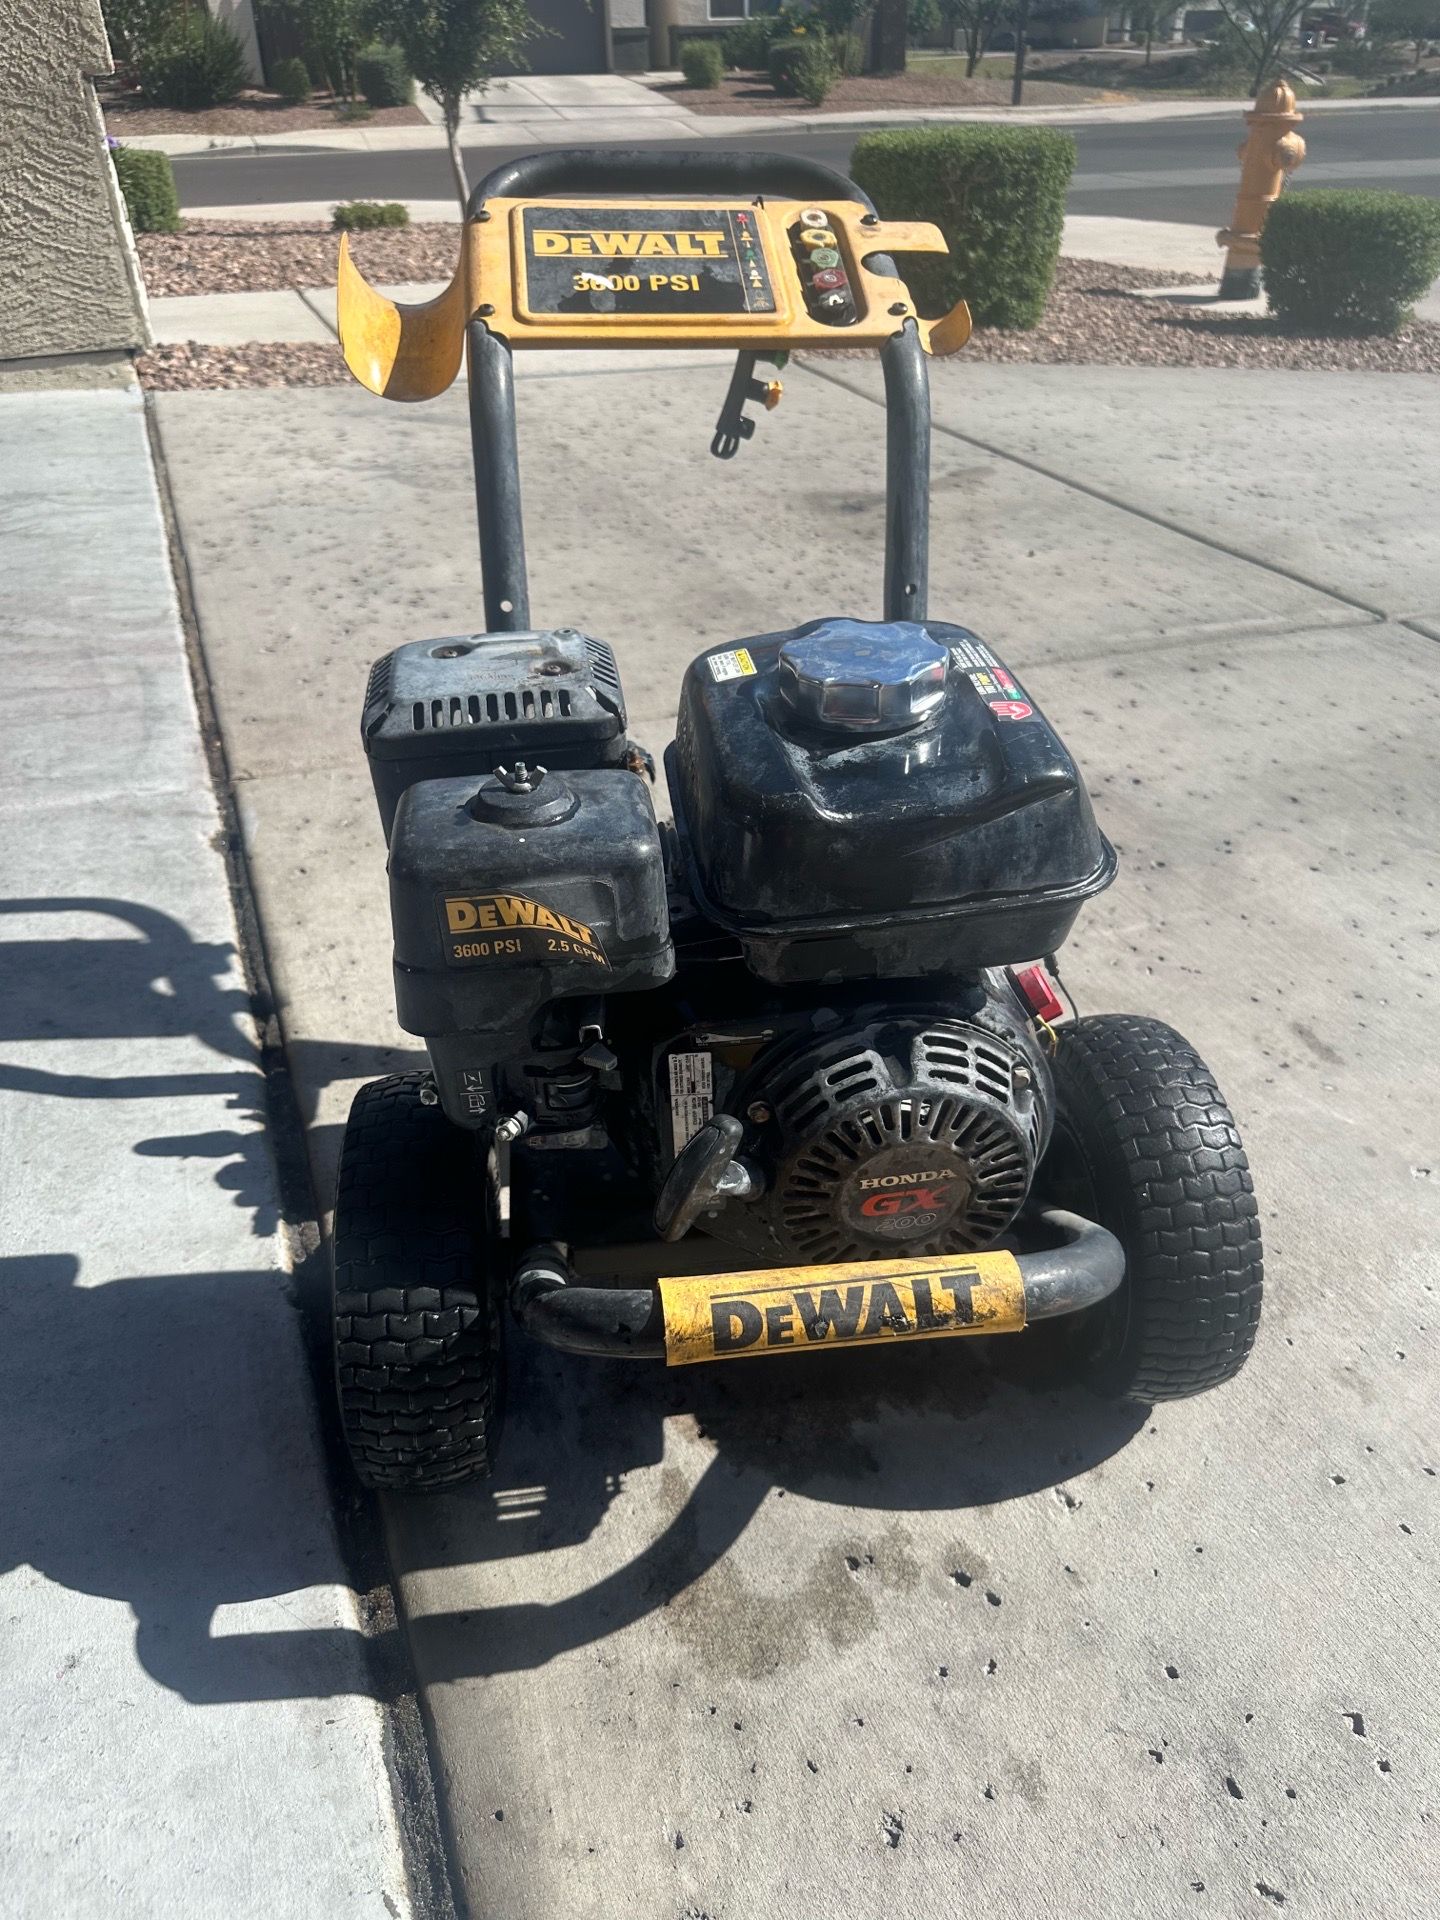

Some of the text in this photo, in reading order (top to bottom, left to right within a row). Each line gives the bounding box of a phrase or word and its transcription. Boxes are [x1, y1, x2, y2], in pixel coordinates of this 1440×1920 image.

[533, 231, 725, 256] DEWALT
[649, 274, 700, 291] PSI
[445, 897, 593, 944] DEWALT
[453, 938, 605, 965] 3600 PSI 2.5 GPM
[860, 1168, 957, 1190] HONDA
[862, 1185, 951, 1217] GX
[875, 1212, 937, 1233] 200
[710, 1273, 983, 1350] DEWALT
